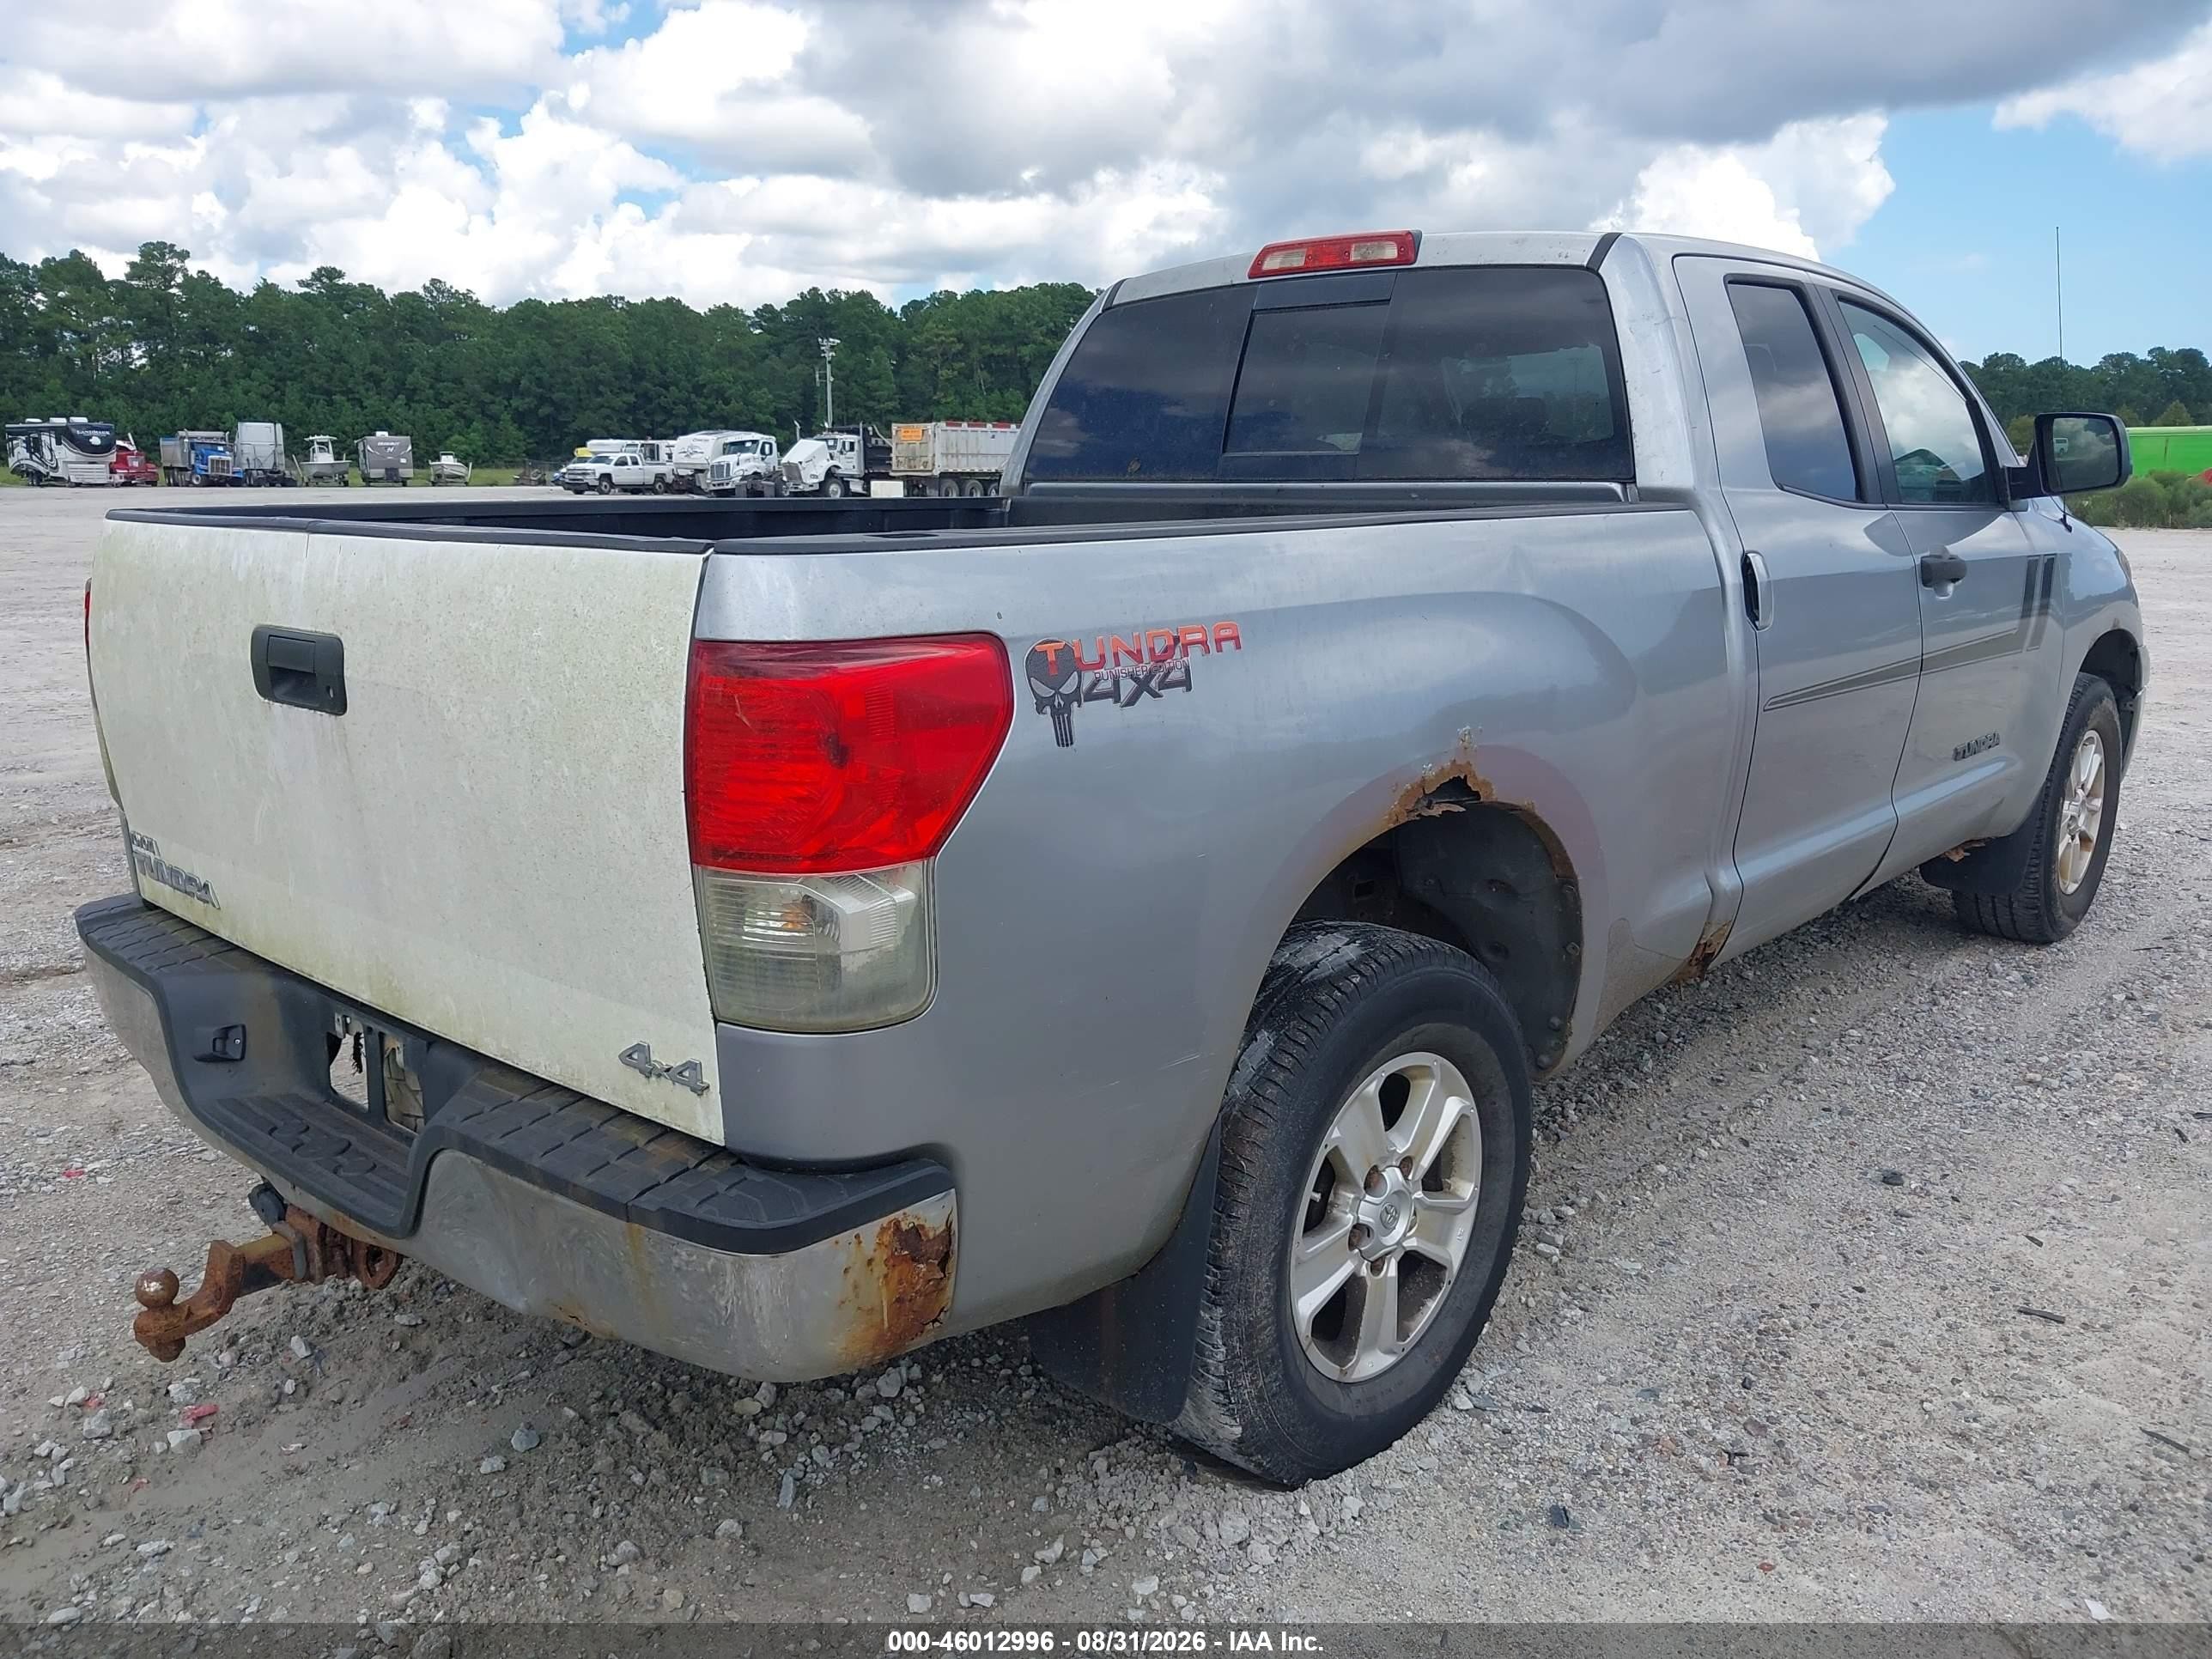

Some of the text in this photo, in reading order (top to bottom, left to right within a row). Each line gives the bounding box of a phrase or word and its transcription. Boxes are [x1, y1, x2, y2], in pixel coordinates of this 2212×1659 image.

[1034, 621, 1242, 676] TUNDRA
[1094, 659, 1190, 682] PUNISHER EDITION
[1953, 732, 2000, 762] TUNDRA
[133, 851, 221, 909] TUNDRA
